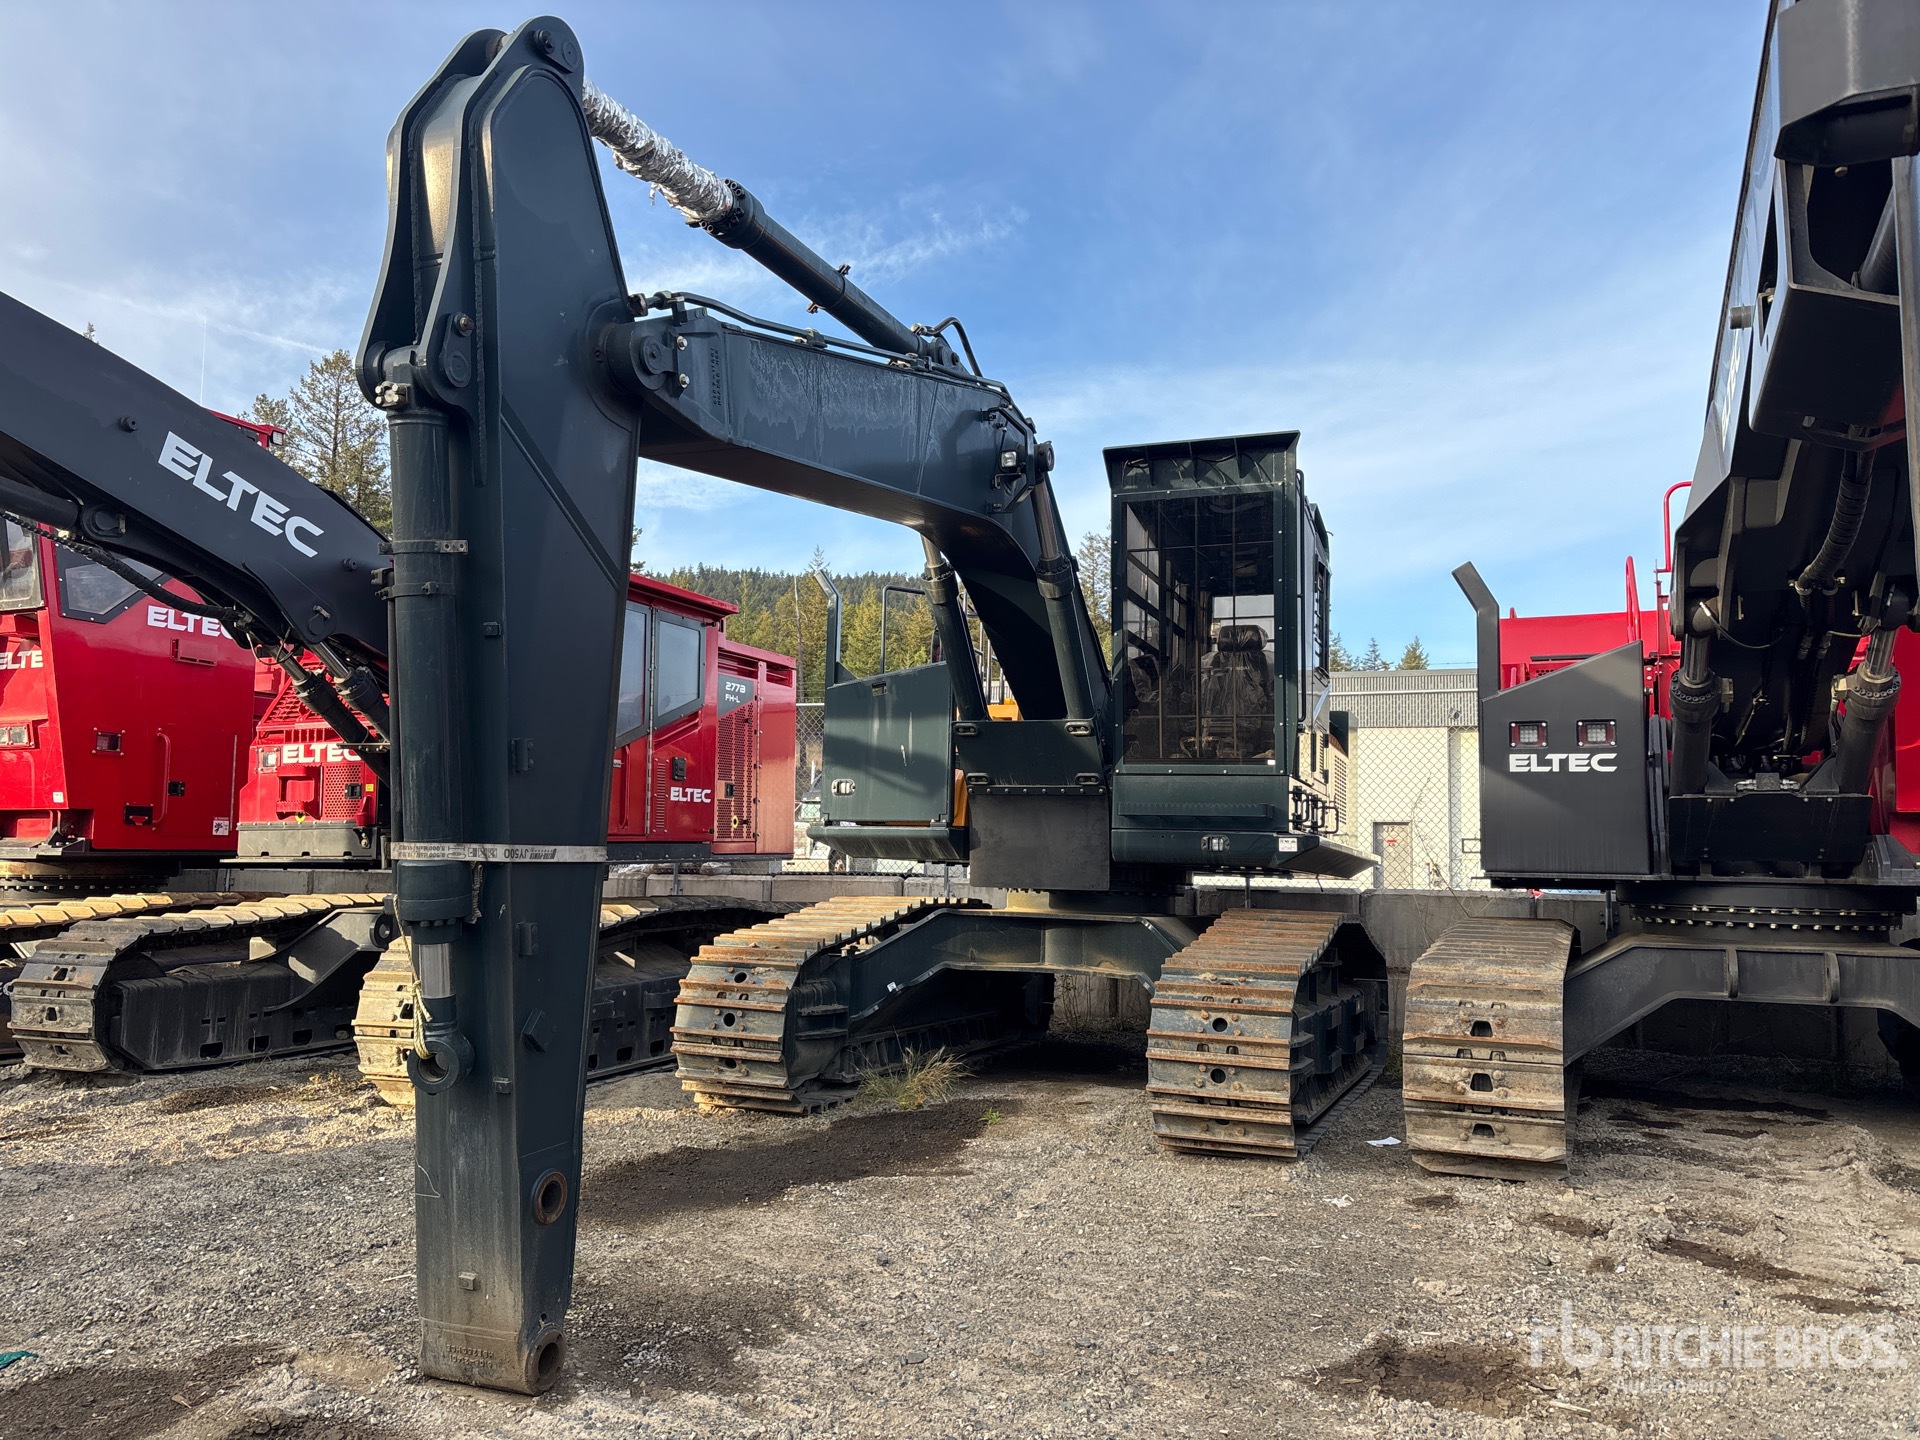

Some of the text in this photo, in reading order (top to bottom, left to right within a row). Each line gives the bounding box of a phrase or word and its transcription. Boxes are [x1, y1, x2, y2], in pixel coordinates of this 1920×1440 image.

[157, 430, 325, 558] ELTEC
[1509, 753, 1618, 773] ELTEC
[670, 786, 712, 803] ELTEC
